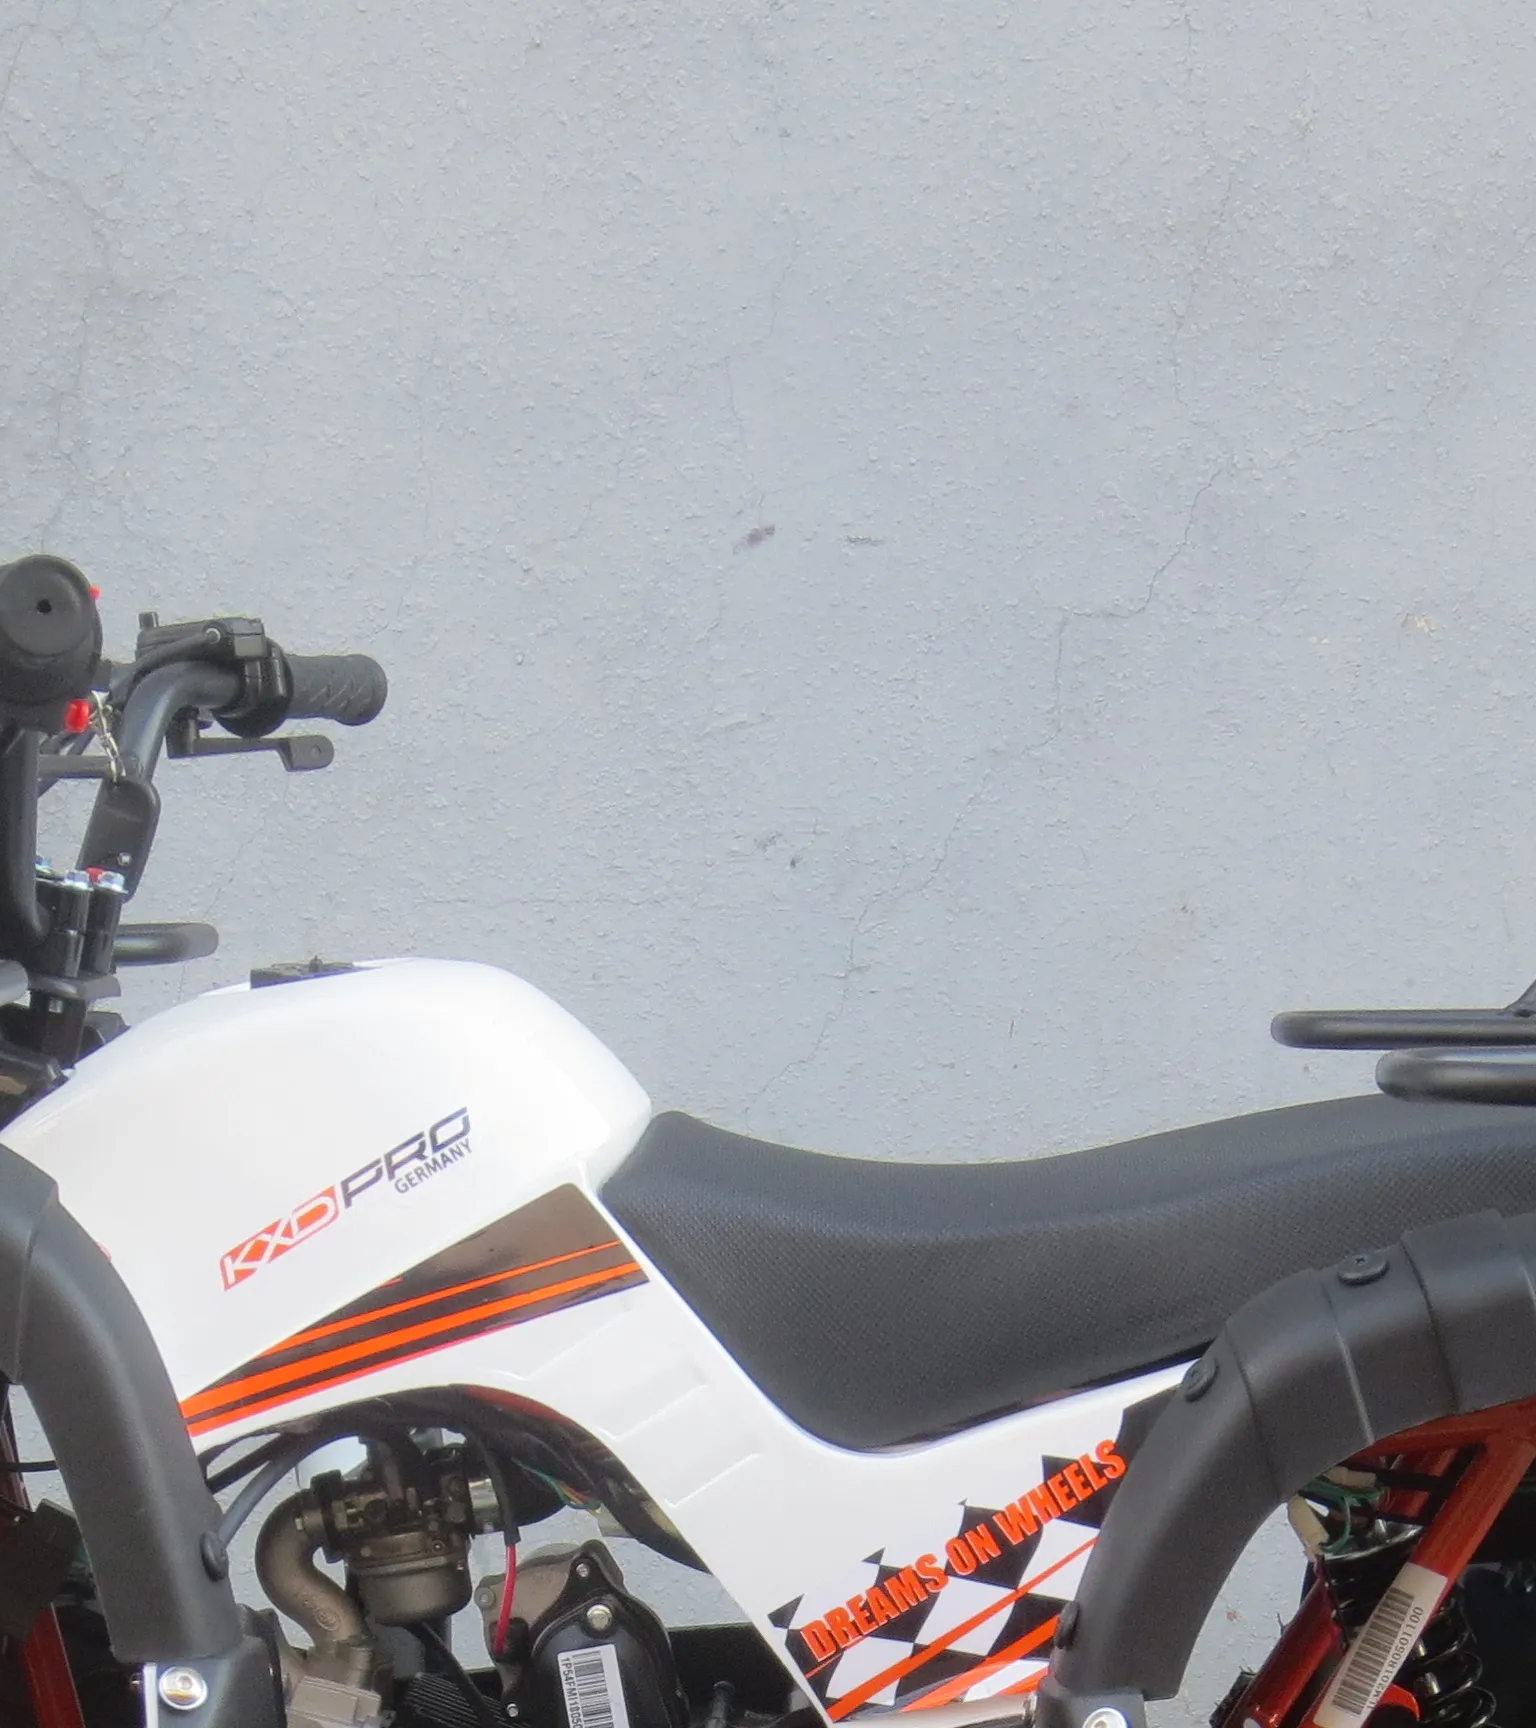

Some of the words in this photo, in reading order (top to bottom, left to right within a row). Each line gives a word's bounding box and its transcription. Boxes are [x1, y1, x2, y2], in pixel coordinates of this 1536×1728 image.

[394, 1138, 473, 1194] GERMANY
[800, 1553, 950, 1662] DREAMS
[944, 1524, 1001, 1576] ON
[992, 1438, 1127, 1546] WHEELS
